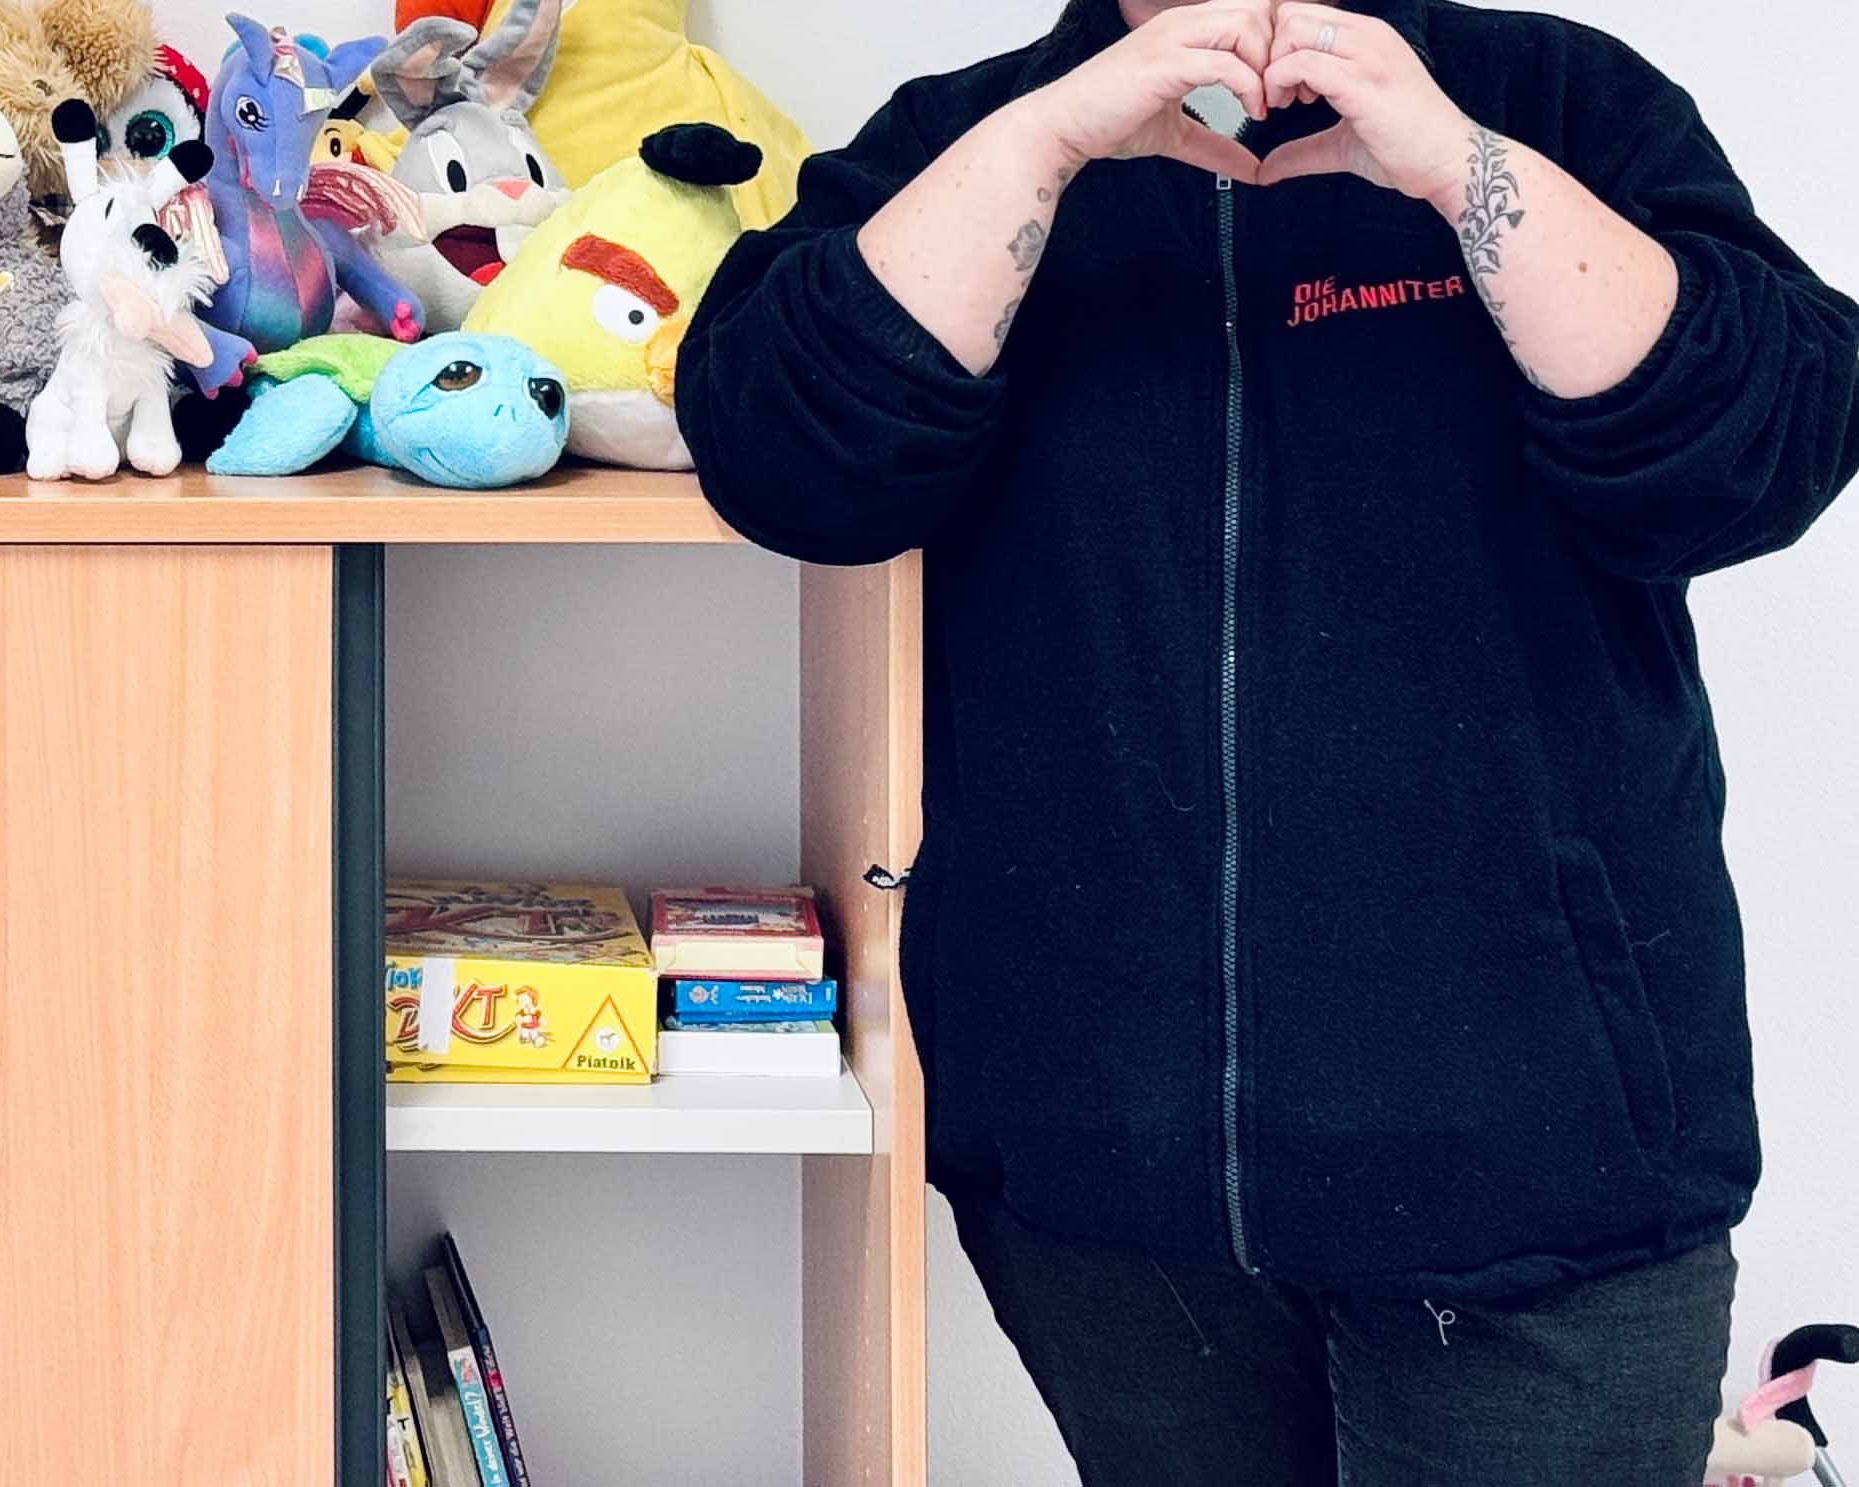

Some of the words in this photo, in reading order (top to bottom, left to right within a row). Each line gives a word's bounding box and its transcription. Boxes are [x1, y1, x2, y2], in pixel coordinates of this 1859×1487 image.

[1286, 276, 1466, 328] JOHANNITER
[1294, 275, 1337, 305] DIE
[576, 1054, 636, 1071] Piatnik
